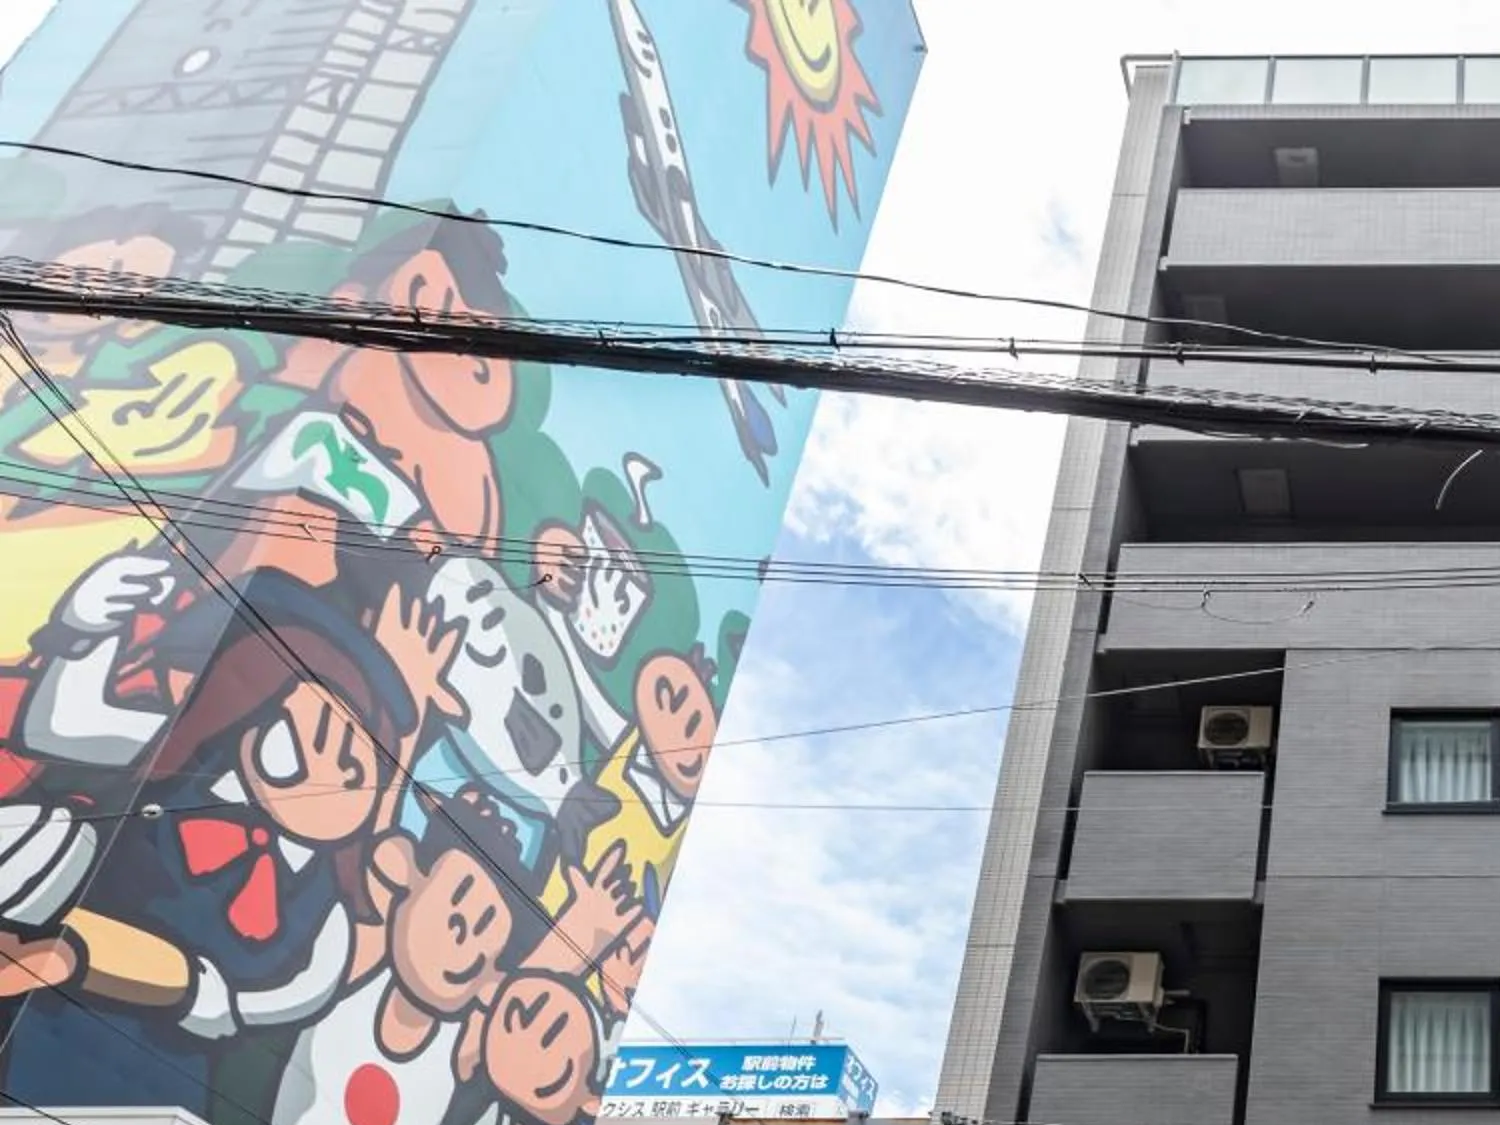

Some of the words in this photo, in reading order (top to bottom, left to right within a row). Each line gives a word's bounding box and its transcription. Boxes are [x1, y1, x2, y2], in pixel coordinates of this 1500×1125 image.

[719, 1074, 829, 1091] お探しの方は
